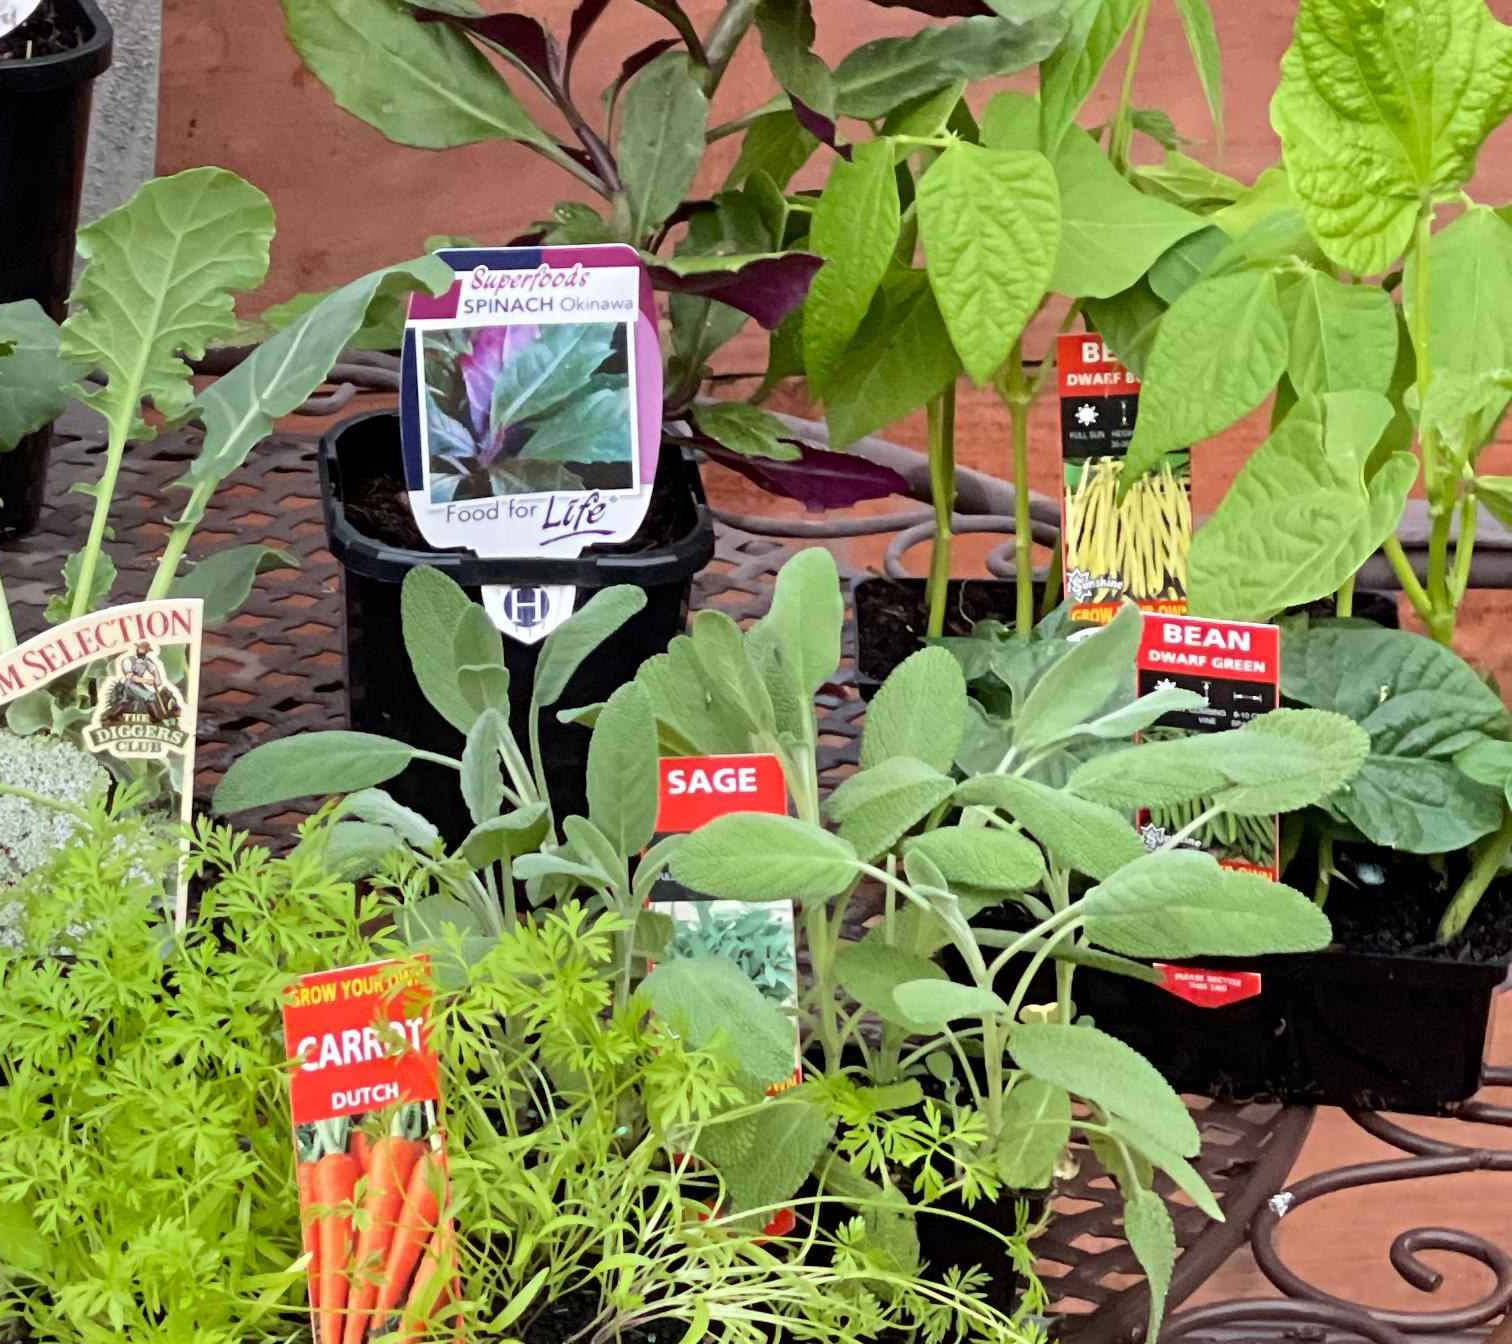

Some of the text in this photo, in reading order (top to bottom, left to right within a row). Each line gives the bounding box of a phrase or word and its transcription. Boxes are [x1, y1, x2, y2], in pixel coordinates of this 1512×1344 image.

[470, 266, 591, 299] Superfoods
[463, 296, 634, 314] SPINACH Okinawa
[1082, 341, 1118, 363] BE
[446, 491, 607, 531] Food for Life
[1071, 604, 1113, 623] GROW
[21, 607, 194, 681] SELECTION
[1162, 622, 1251, 652] BEAN
[1148, 649, 1266, 674] DWARF GREEN
[122, 713, 151, 723] THE
[96, 724, 184, 745] DIGGERS
[115, 741, 162, 753] CLUB
[667, 767, 757, 796] SAGE
[291, 982, 337, 1008] GROW
[340, 976, 385, 1001] YOUR
[331, 1081, 400, 1111] DUTCH
